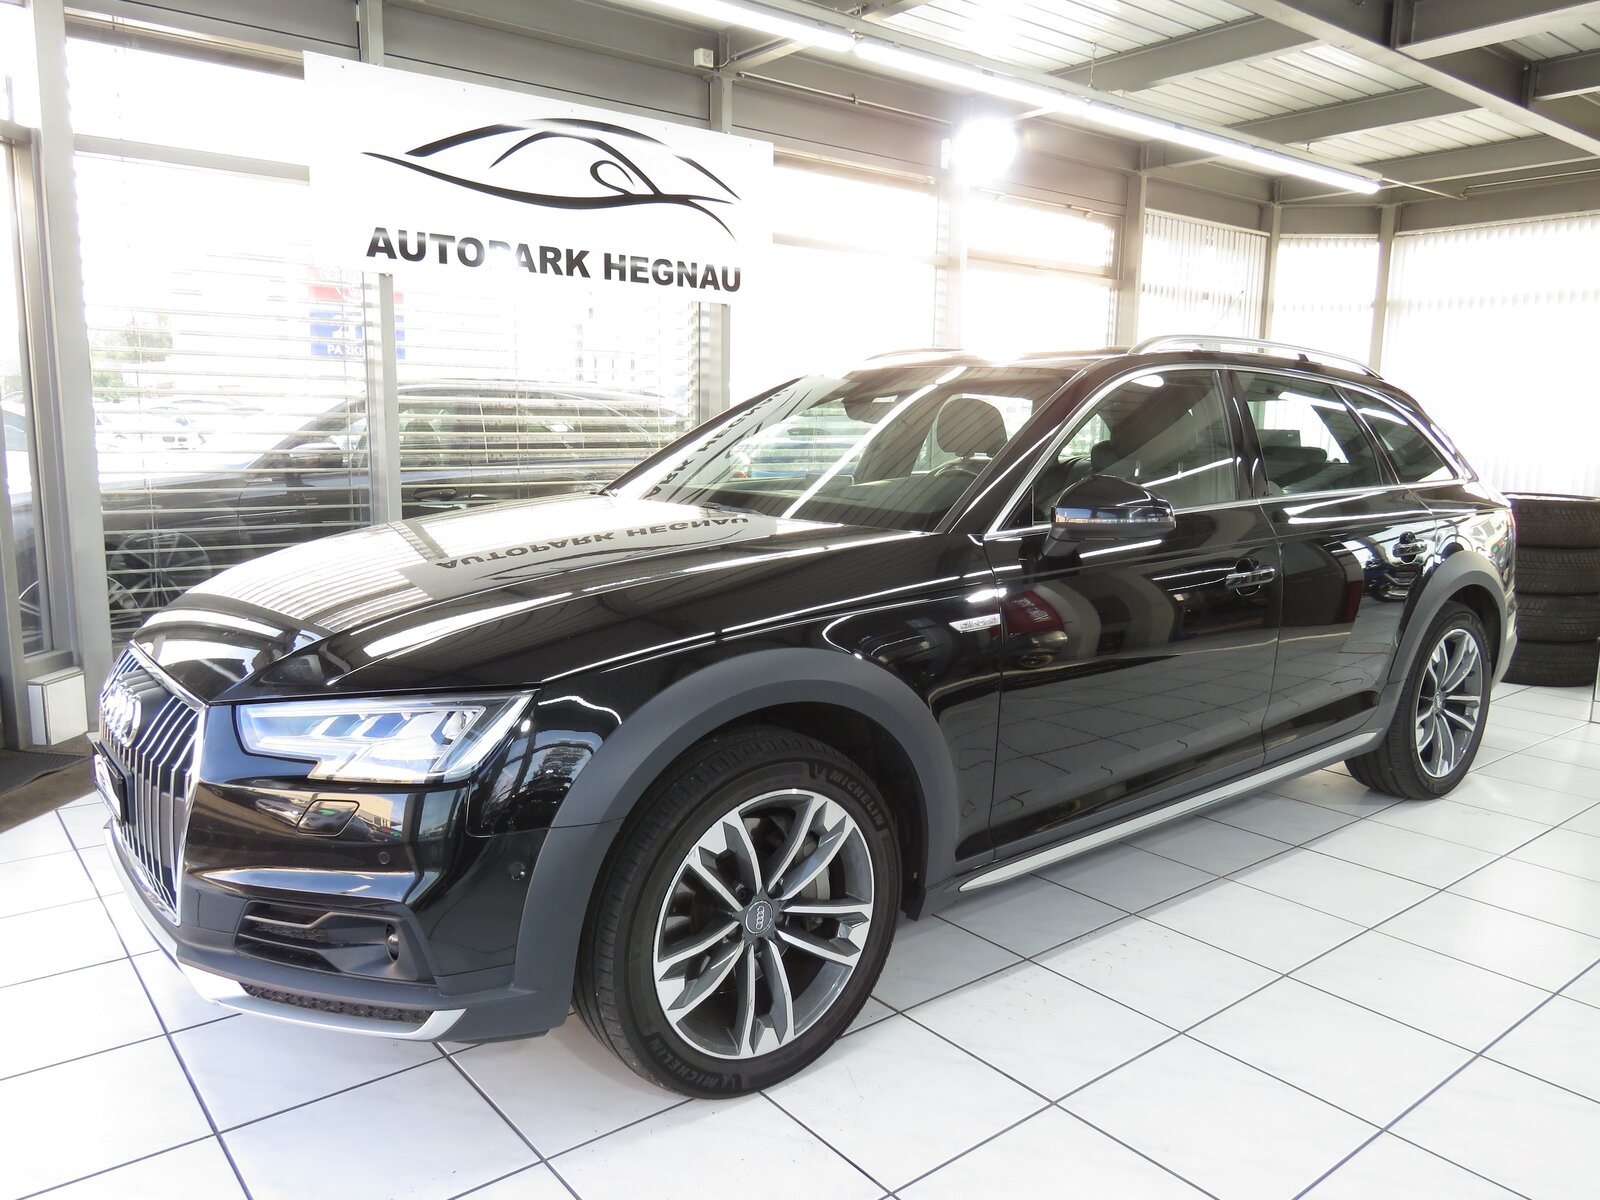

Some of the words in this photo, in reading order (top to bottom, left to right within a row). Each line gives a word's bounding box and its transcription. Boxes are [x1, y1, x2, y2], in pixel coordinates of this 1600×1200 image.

[603, 252, 741, 292] HEGNAU
[829, 769, 885, 827] MICHELIN
[648, 1038, 719, 1088] MICHELIN
